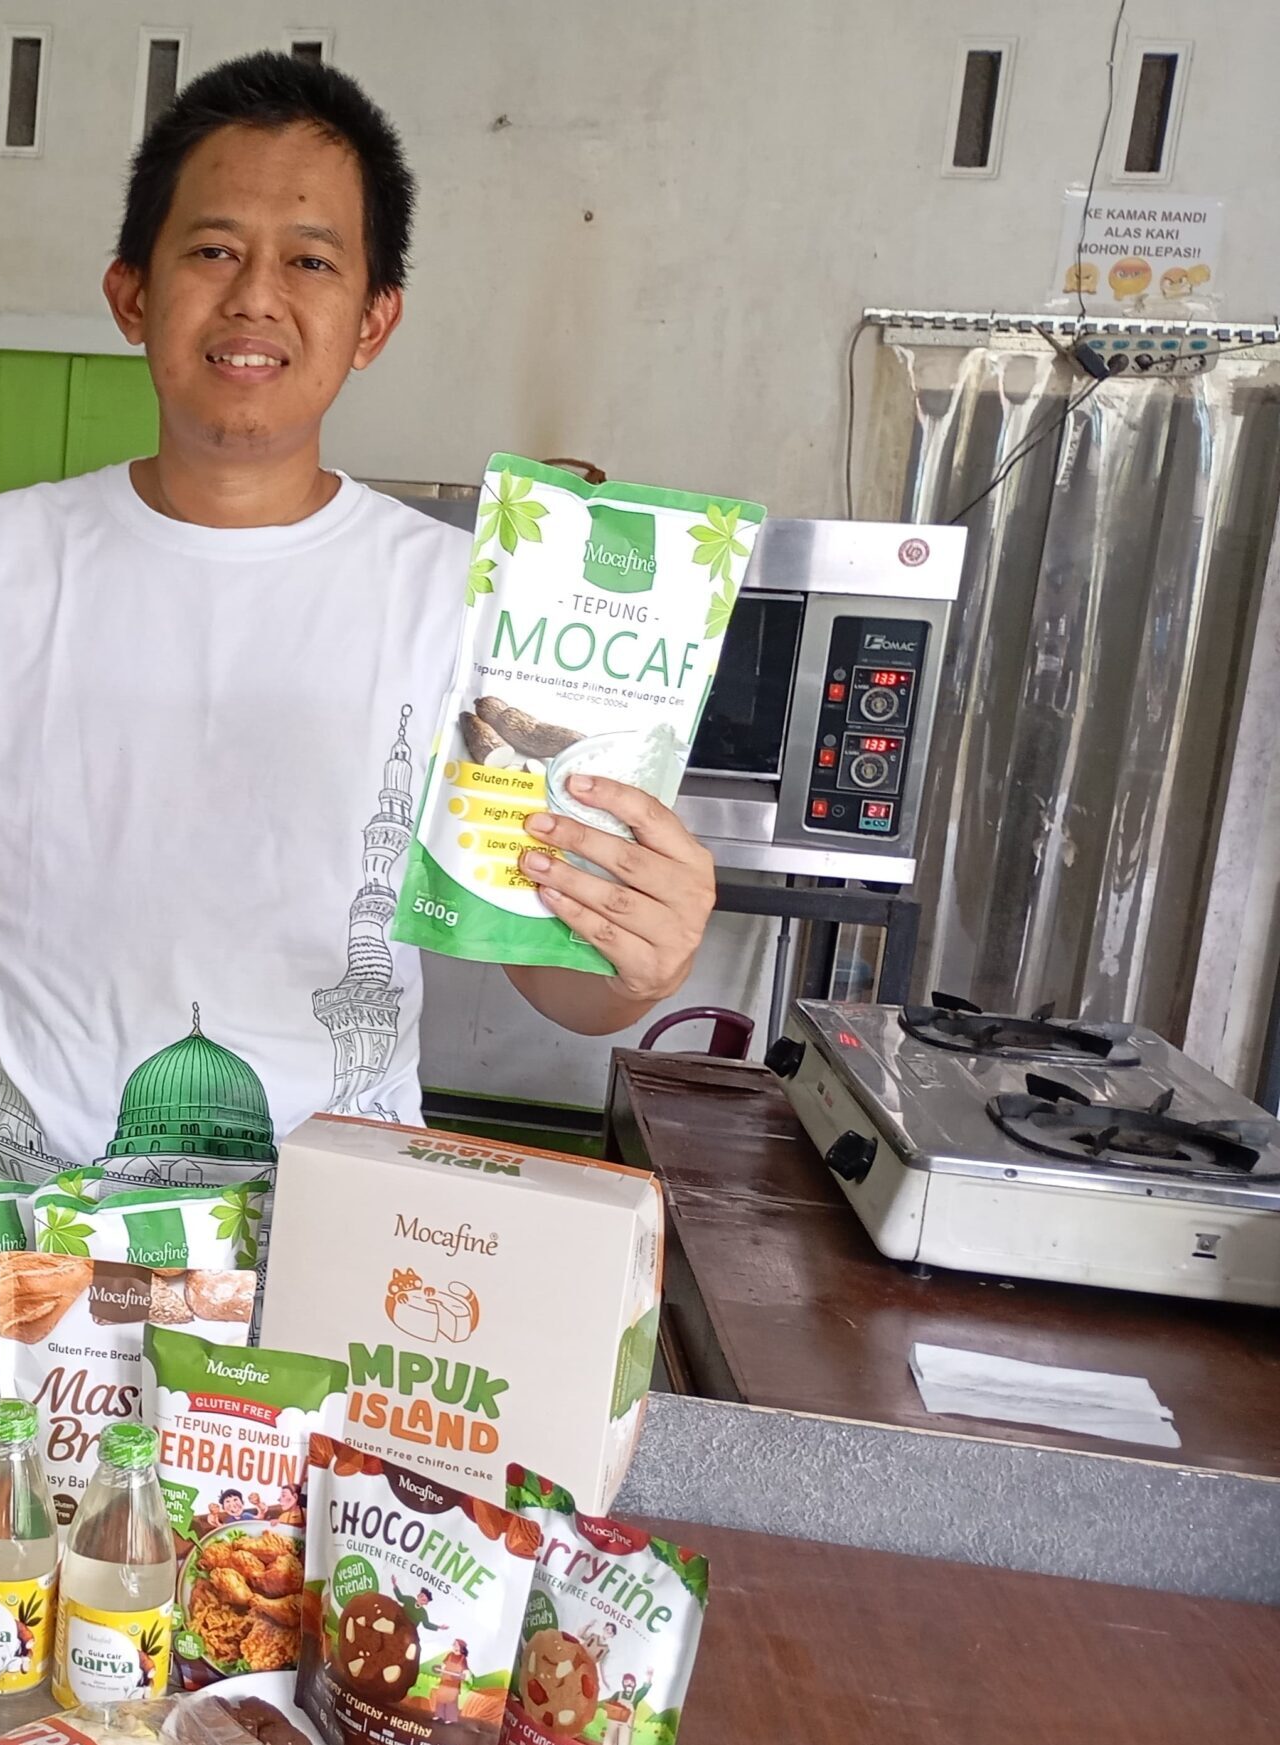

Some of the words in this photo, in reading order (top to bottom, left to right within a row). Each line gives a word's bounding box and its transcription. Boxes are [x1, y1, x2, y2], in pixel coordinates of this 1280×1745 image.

[1085, 207, 1103, 220] KE
[1106, 208, 1157, 222] KAMAR
[1161, 211, 1207, 224] MANDI
[1104, 226, 1142, 239] ALAS
[1145, 228, 1180, 241] KAKI
[1078, 243, 1129, 256] MOHON
[1132, 245, 1201, 259] DILEPAS!!
[491, 609, 699, 689] MOCAF
[516, 671, 579, 690] Berkualitas
[582, 681, 618, 696] Pilihan
[621, 688, 666, 705] Keluarga
[874, 672, 897, 685] 133
[864, 738, 887, 751] 133
[471, 771, 509, 787] Gluten
[512, 777, 534, 790] Free
[483, 806, 508, 822] High
[487, 838, 506, 851] Low
[412, 896, 459, 927] 500g
[398, 1145, 521, 1176] MPUK
[47, 1342, 82, 1356] Gluten
[84, 1347, 108, 1359] Free
[110, 1350, 141, 1362] Bread
[206, 1358, 270, 1386] Mocafine
[348, 1342, 509, 1419] MPUK
[194, 1396, 240, 1414] GLUTEN
[242, 1404, 273, 1421] FREE
[174, 1414, 233, 1438] TEPUNG
[239, 1427, 290, 1449] BUMBU
[348, 1391, 499, 1455] ISLAND
[344, 1436, 382, 1455] Gluten
[386, 1446, 413, 1461] Free
[417, 1454, 460, 1473] Chiffon
[464, 1466, 493, 1482] Cake
[398, 1474, 444, 1506] Mocafine
[346, 1539, 382, 1559] GLUTEN
[384, 1551, 408, 1570] FREE
[409, 1563, 453, 1596] COOKIES
[565, 1583, 588, 1603] FREE
[590, 1596, 633, 1630] COOKIES
[71, 1647, 133, 1674] Garva
